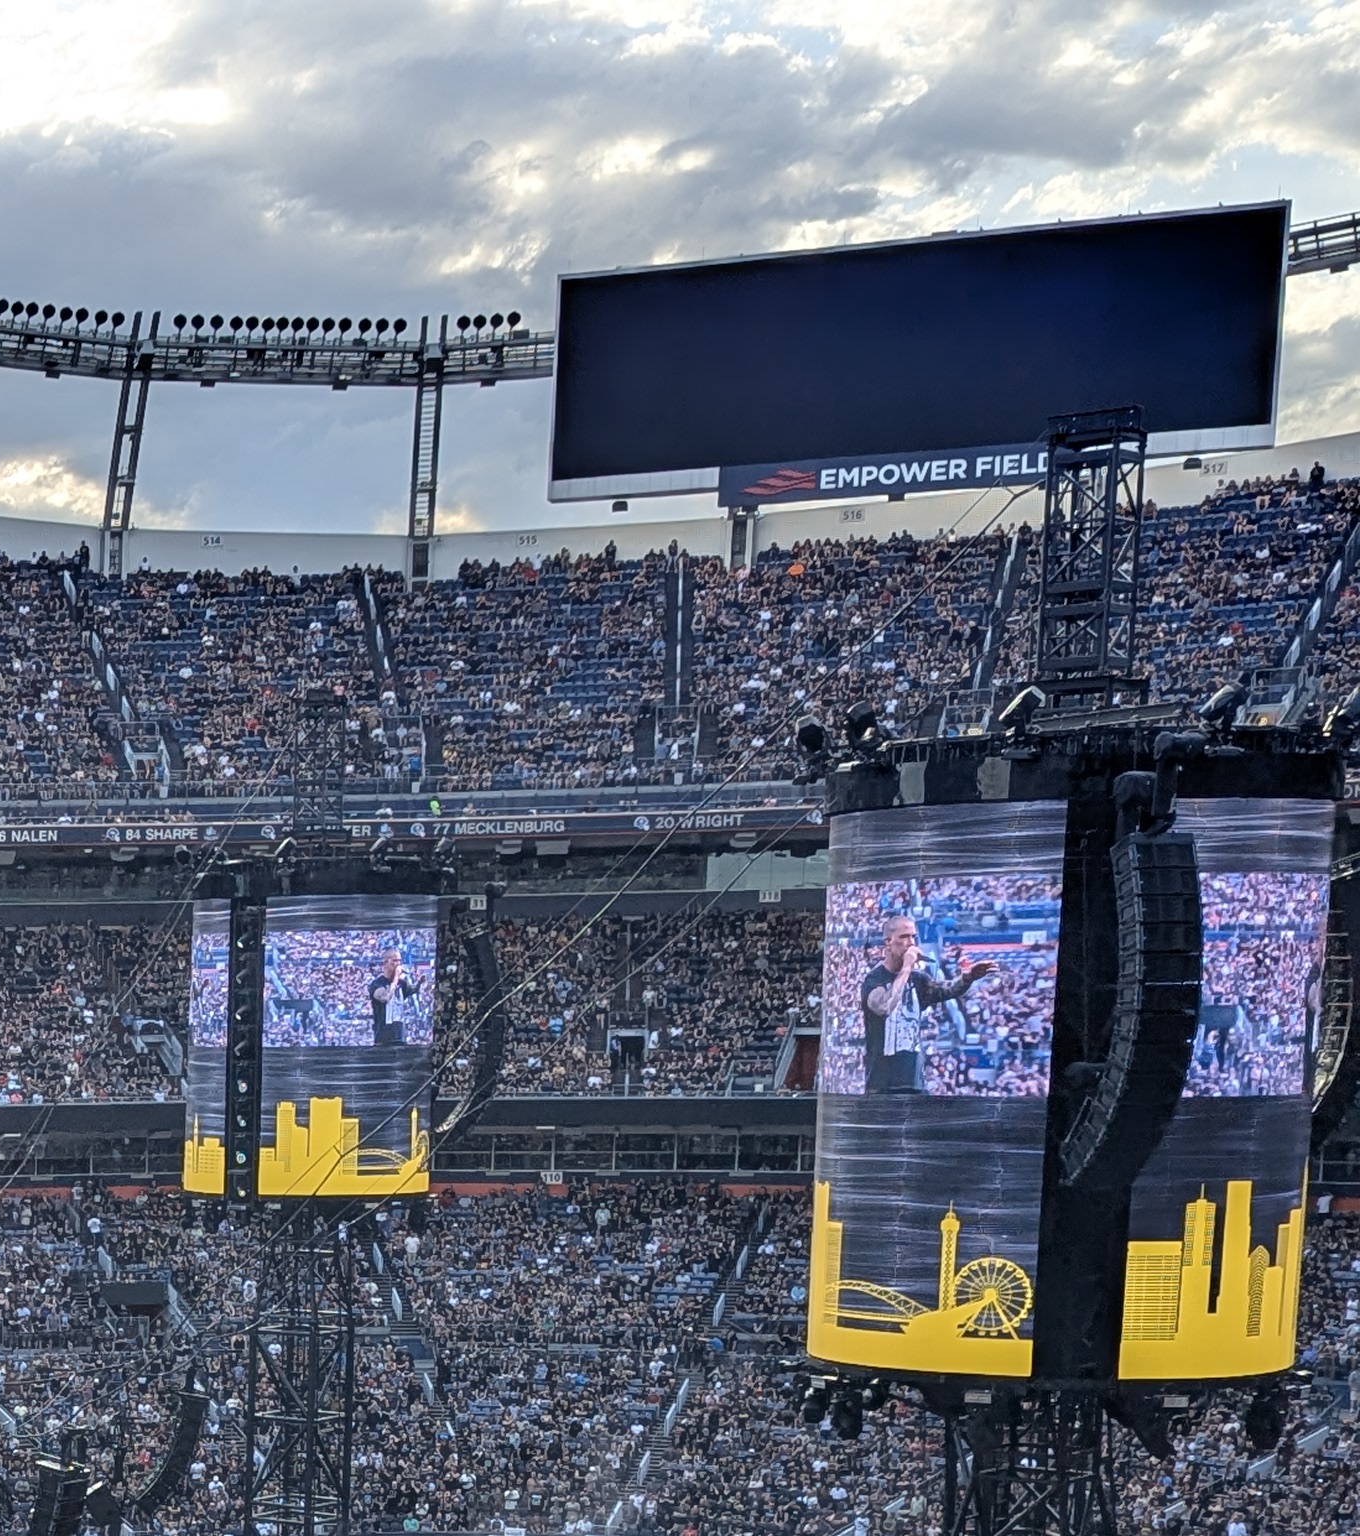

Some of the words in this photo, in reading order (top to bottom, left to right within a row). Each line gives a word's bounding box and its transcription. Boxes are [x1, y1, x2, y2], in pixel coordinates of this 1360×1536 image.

[820, 459, 967, 490] EMPOWER
[1203, 462, 1224, 474] 517
[843, 510, 862, 520] 516
[203, 535, 221, 545] 514
[519, 535, 537, 545] 515
[432, 822, 451, 835] 77
[455, 820, 565, 835] MECKLENBURG
[655, 816, 675, 829] 20
[679, 814, 745, 829] WRIGHT
[11, 829, 58, 843] NALEN
[125, 828, 141, 841] 84
[145, 828, 198, 841] SHARPE
